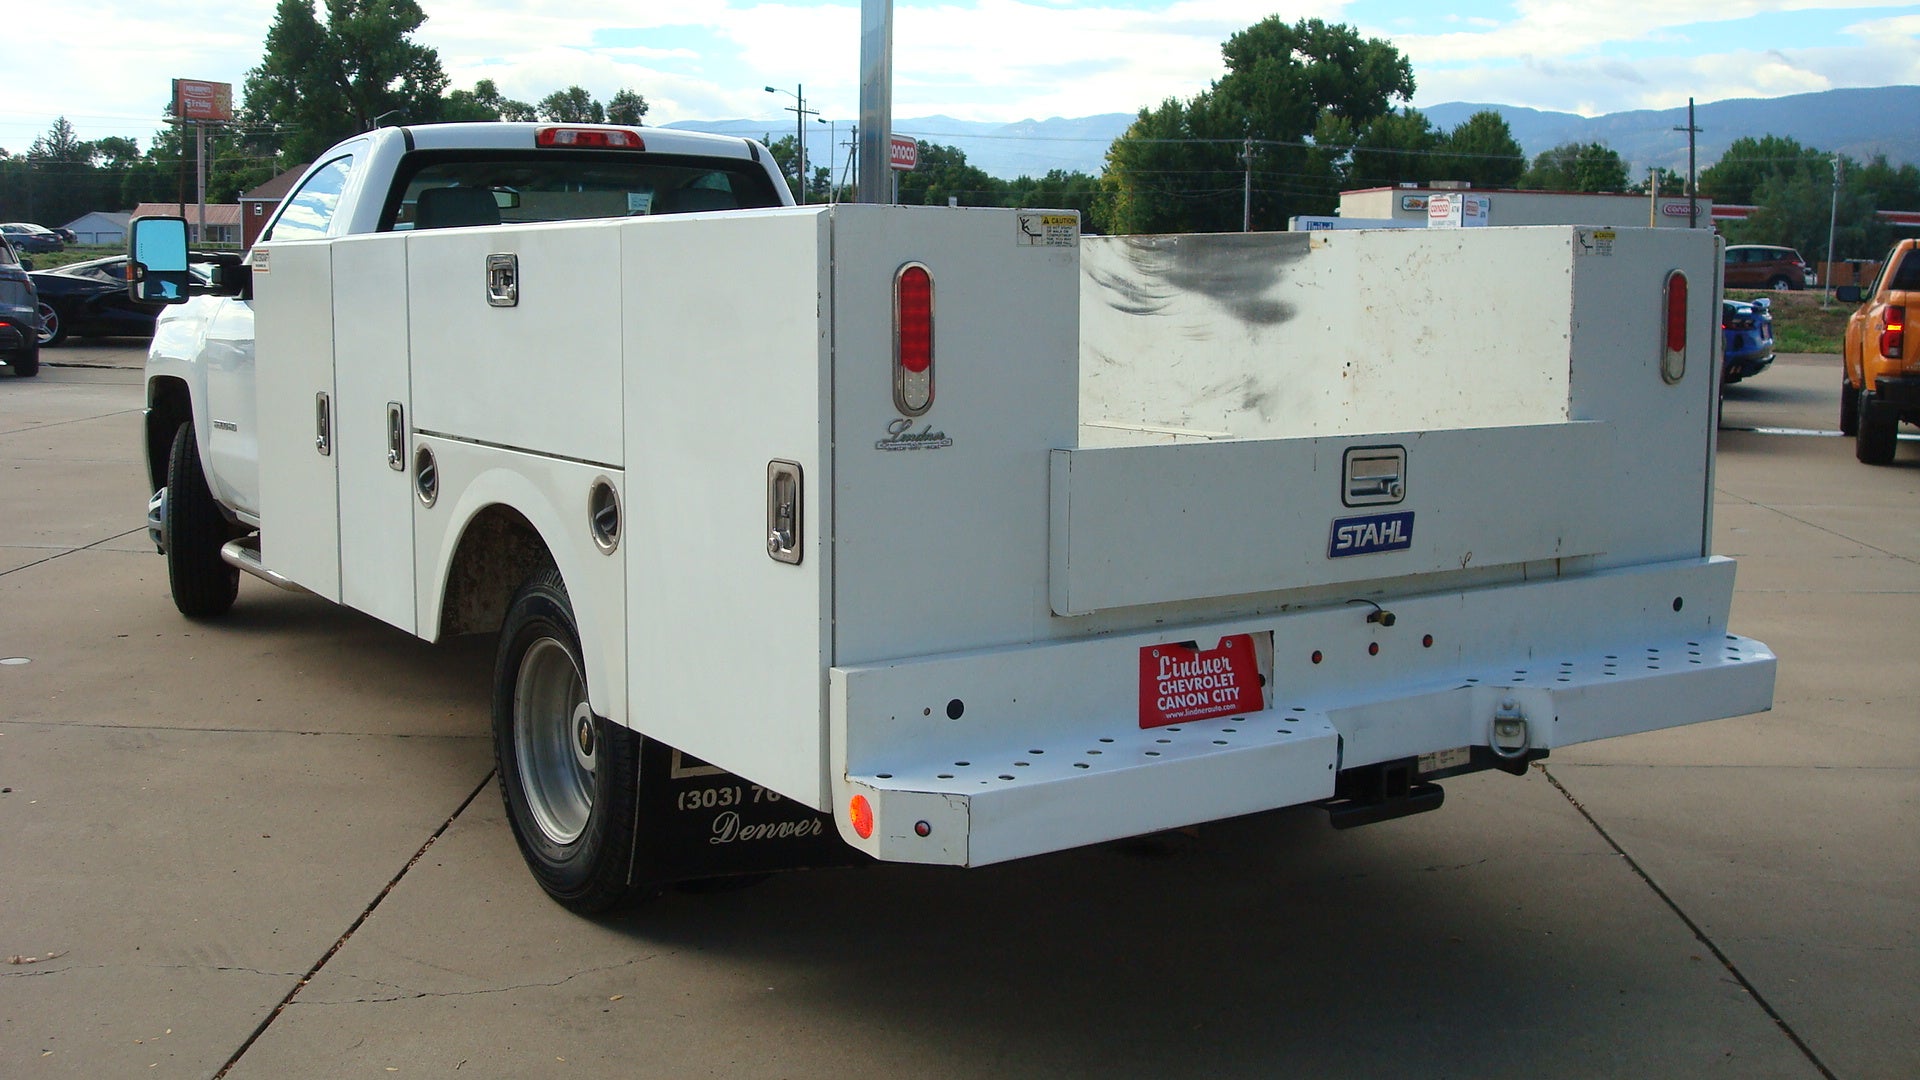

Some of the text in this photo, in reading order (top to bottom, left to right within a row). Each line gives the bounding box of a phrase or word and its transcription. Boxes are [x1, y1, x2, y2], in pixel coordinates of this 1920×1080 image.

[891, 144, 915, 160] onoco
[1336, 520, 1408, 550] STAHL
[1157, 652, 1232, 680] Lindner
[1159, 673, 1235, 695] CHEVROLET
[1157, 686, 1240, 711] CANON CITY
[1165, 703, 1236, 719] www.lindnerauto.com
[678, 786, 742, 811] (303)
[709, 811, 823, 844] Denver
